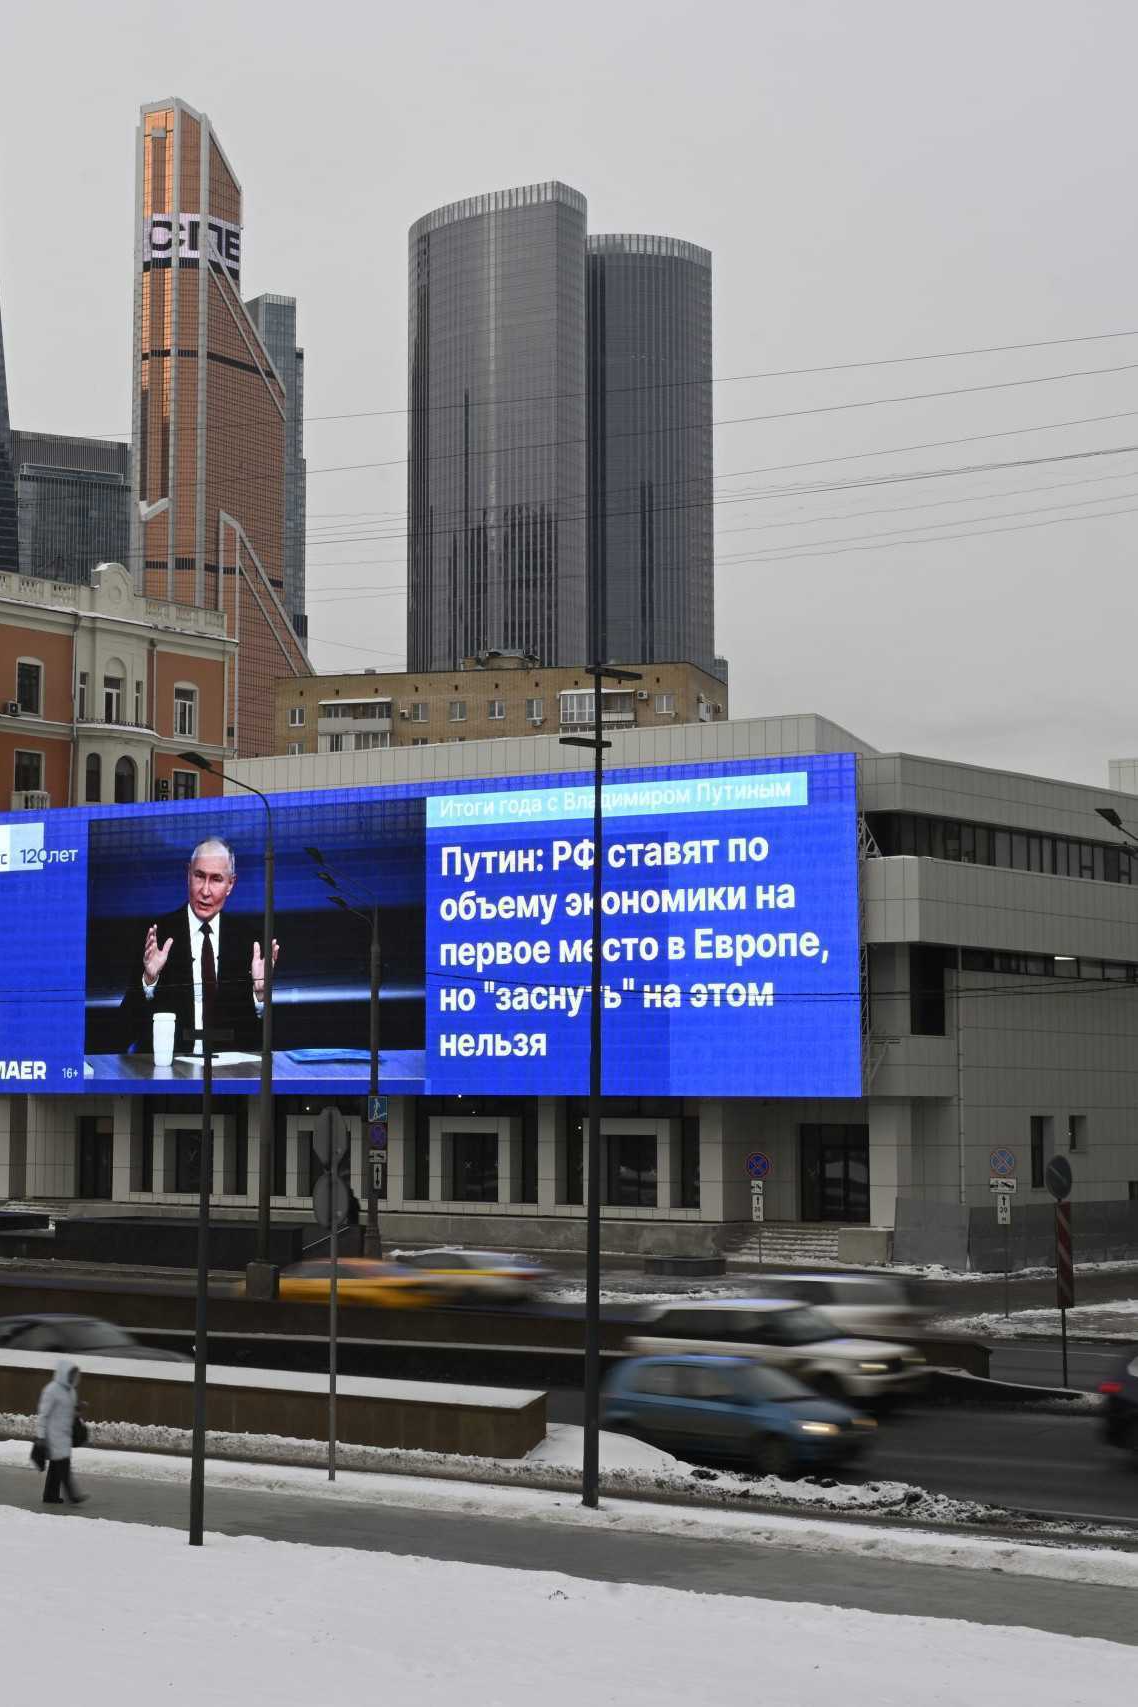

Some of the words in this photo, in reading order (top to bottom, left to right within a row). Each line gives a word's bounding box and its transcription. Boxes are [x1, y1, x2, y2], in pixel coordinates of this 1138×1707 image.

[440, 798, 495, 817] Итоги
[499, 796, 543, 816] года
[547, 797, 558, 812] с
[564, 786, 691, 812] Владимиром
[696, 781, 791, 806] Путиным
[441, 845, 544, 882] Путин:
[552, 838, 595, 870] РФ
[607, 839, 720, 868] ставят
[727, 836, 769, 863] по
[440, 890, 558, 925] объему
[565, 885, 747, 917] экономики
[755, 883, 796, 909] на
[440, 940, 551, 973] первое
[667, 936, 686, 960] в
[694, 928, 829, 967] Европе,
[440, 987, 476, 1012] но
[643, 983, 682, 1009] на
[690, 982, 774, 1009] этом
[440, 1032, 547, 1057] нельзя
[61, 1067, 79, 1079] 16+
